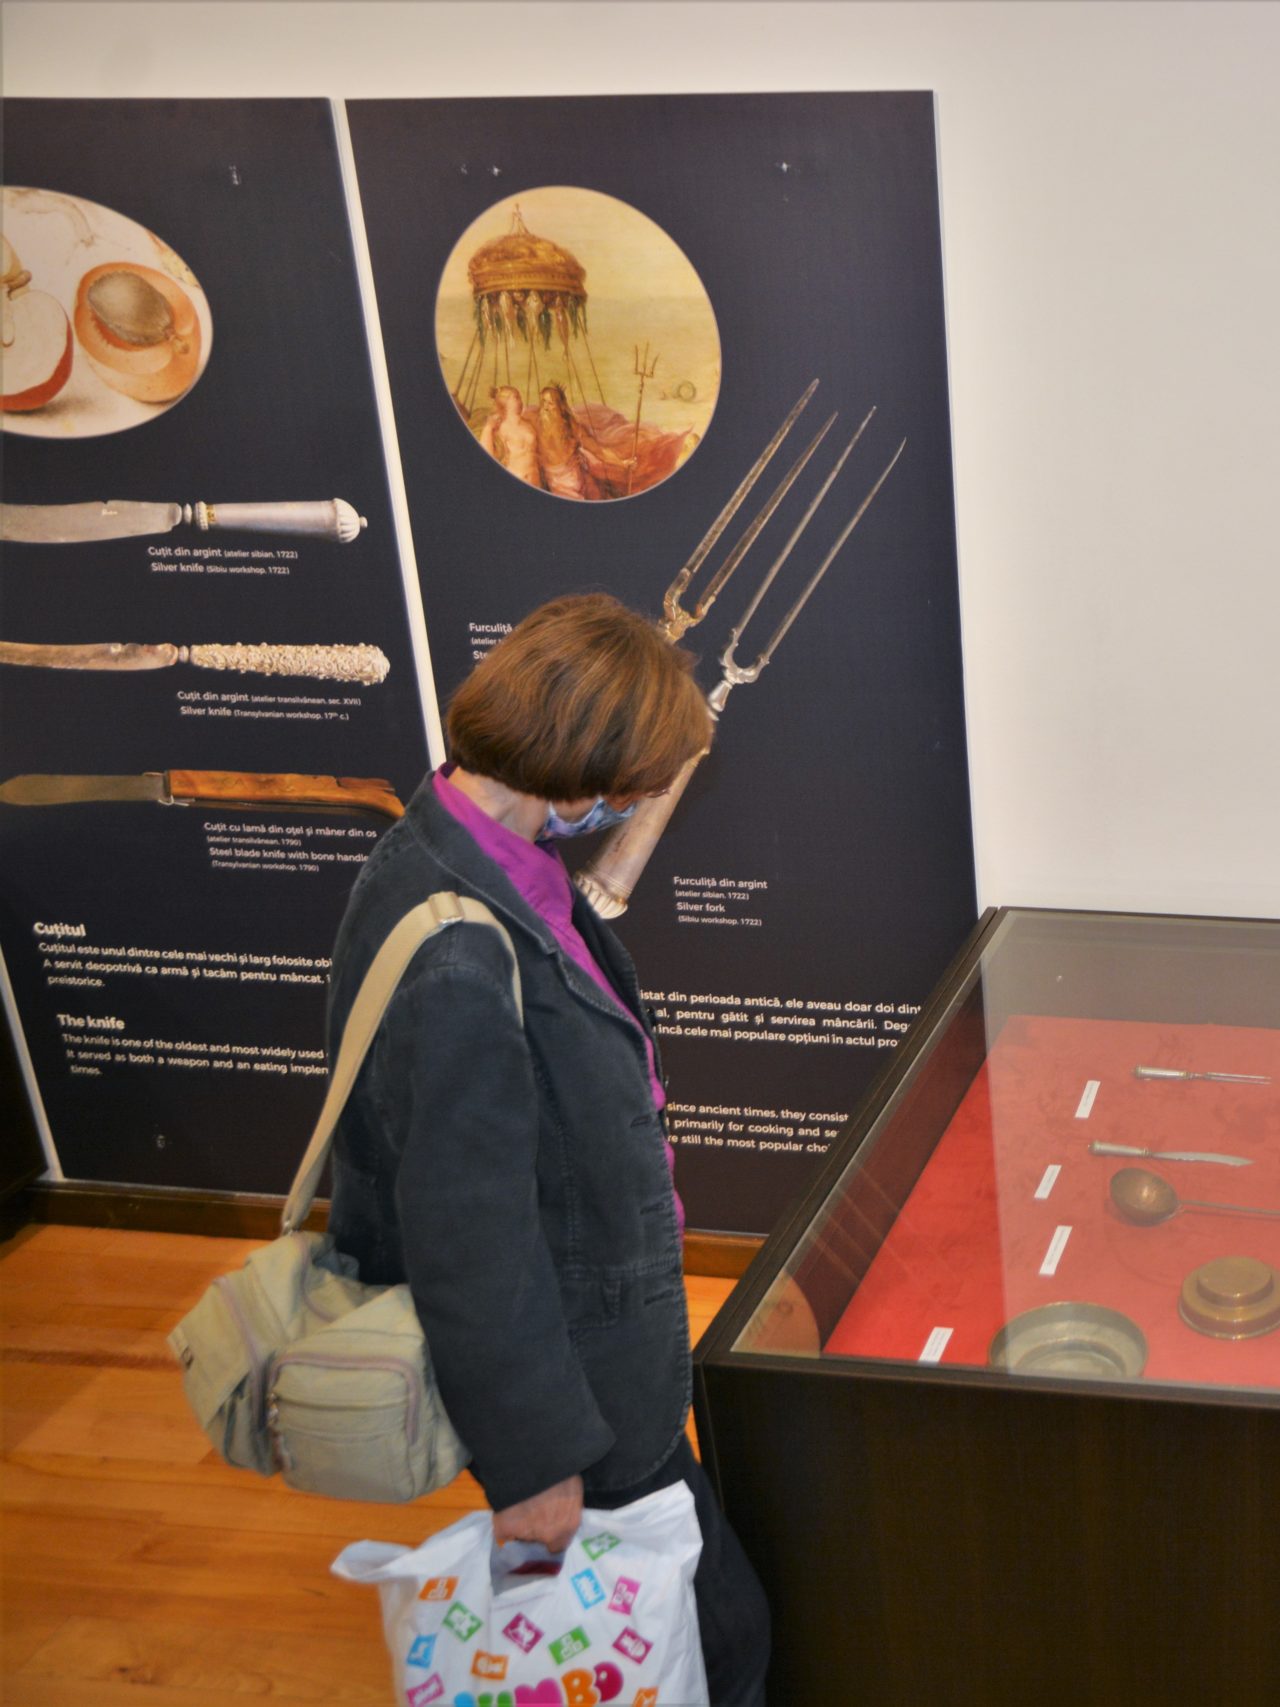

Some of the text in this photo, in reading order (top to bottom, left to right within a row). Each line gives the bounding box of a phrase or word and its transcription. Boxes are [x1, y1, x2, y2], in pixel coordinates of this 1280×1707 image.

[174, 547, 191, 556] din
[192, 547, 222, 559] argint
[151, 562, 178, 572] Silver
[179, 563, 204, 573] knife
[202, 691, 219, 701] din
[220, 692, 250, 704] argint
[180, 706, 206, 715] Silver
[208, 707, 232, 716] knife
[267, 825, 284, 834] din
[347, 828, 364, 837] din
[365, 830, 377, 838] os
[209, 847, 233, 856] Steel
[234, 848, 261, 858] blade
[262, 849, 286, 859] knife
[287, 851, 309, 860] with
[310, 851, 335, 861] bone
[718, 878, 736, 887] din
[737, 880, 768, 890] argint
[676, 902, 725, 912] Silver fork
[77, 946, 100, 955] este
[101, 947, 126, 956] unul
[127, 947, 160, 958] dintre
[161, 949, 184, 960] cele
[185, 951, 207, 961] mai
[208, 952, 238, 962] vechi
[249, 954, 271, 966] larg
[271, 955, 313, 967] folosite
[44, 959, 51, 967] A
[144, 966, 158, 974] ca
[240, 971, 277, 981] pentru
[47, 976, 105, 987] preistorice.
[667, 992, 687, 1002] din
[690, 993, 741, 1005] perioada
[785, 998, 804, 1009] ele
[806, 1001, 841, 1011] aveau
[844, 1001, 872, 1012] doar
[875, 1003, 894, 1013] doi
[57, 1014, 125, 1030] The knife
[676, 1010, 715, 1021] pentru
[770, 1015, 816, 1026] servirea
[884, 1020, 910, 1033] Deg
[684, 1026, 708, 1036] cele
[710, 1028, 732, 1038] mai
[733, 1030, 786, 1041] populare
[831, 1034, 844, 1044] în
[845, 1036, 875, 1046] actul
[62, 1034, 324, 1059] The knife is one of the oldest and most widely used
[70, 1065, 101, 1075] times.
[78, 1052, 111, 1060] served
[129, 1053, 154, 1063] both
[157, 1056, 164, 1064] a
[167, 1057, 210, 1068] weapon
[213, 1059, 234, 1069] and
[236, 1062, 251, 1070] an
[253, 1062, 288, 1074] eating
[667, 1102, 696, 1113] since
[698, 1104, 741, 1116] ancient
[780, 1109, 806, 1121] they
[674, 1119, 820, 1137] primarily for cooking and
[681, 1134, 830, 1153] still the most popular cho
